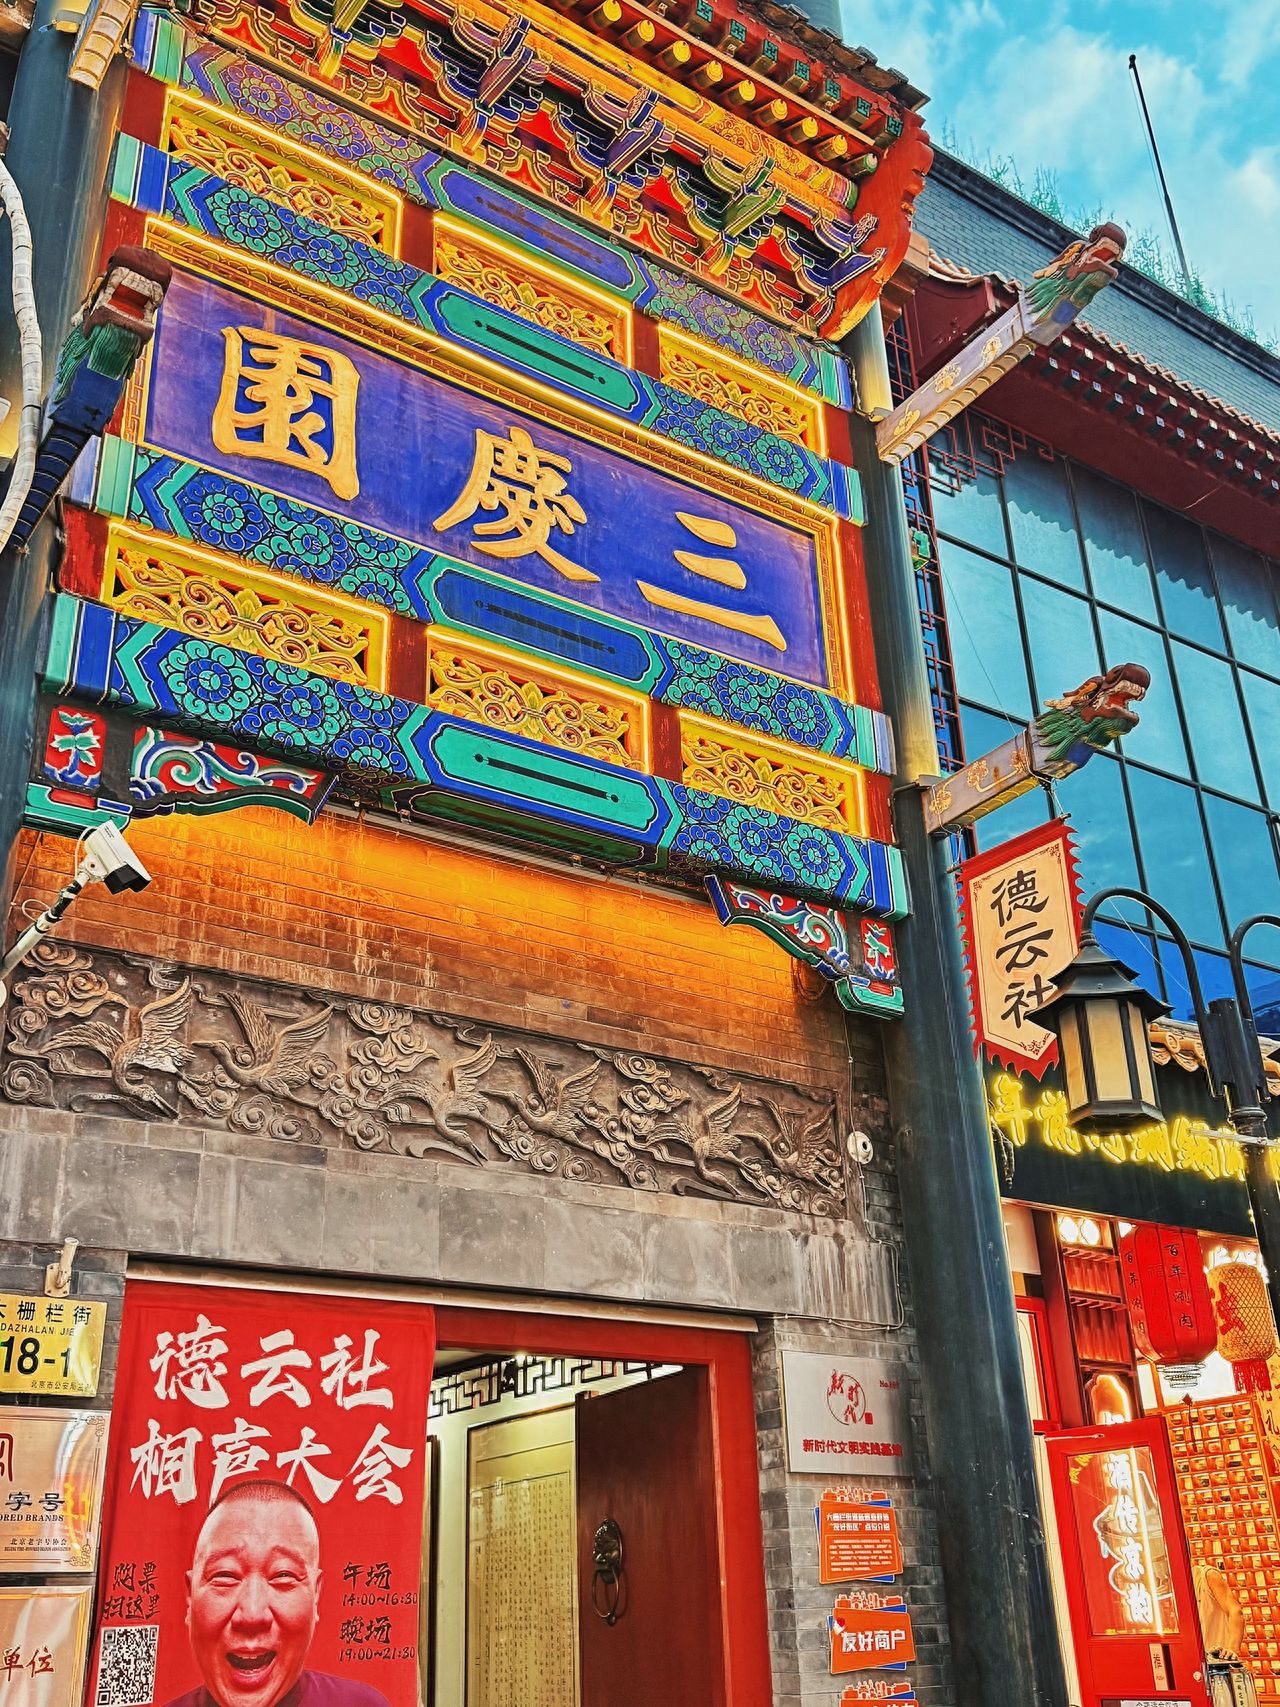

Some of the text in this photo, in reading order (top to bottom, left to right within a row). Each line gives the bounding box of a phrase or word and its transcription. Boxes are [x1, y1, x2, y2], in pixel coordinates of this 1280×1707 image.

[990, 869, 1056, 1028] 德云社
[1, 1323, 54, 1335] DAZHALAN
[0, 1336, 71, 1378] 18-1
[150, 1314, 394, 1410] 德云社
[130, 1417, 414, 1507] 相声大会
[5, 1491, 65, 1511] 字号
[26, 1514, 64, 1522] BRANDS
[112, 1561, 159, 1594] 购票
[343, 1561, 392, 1590] 午场
[101, 1594, 160, 1621] 扫这里
[343, 1592, 417, 1606] 14:00~16:30
[340, 1615, 392, 1644] 晚场
[842, 1629, 906, 1652] 友好商户
[0, 1643, 55, 1681] 单位
[340, 1646, 415, 1662] 19:00~21:30
